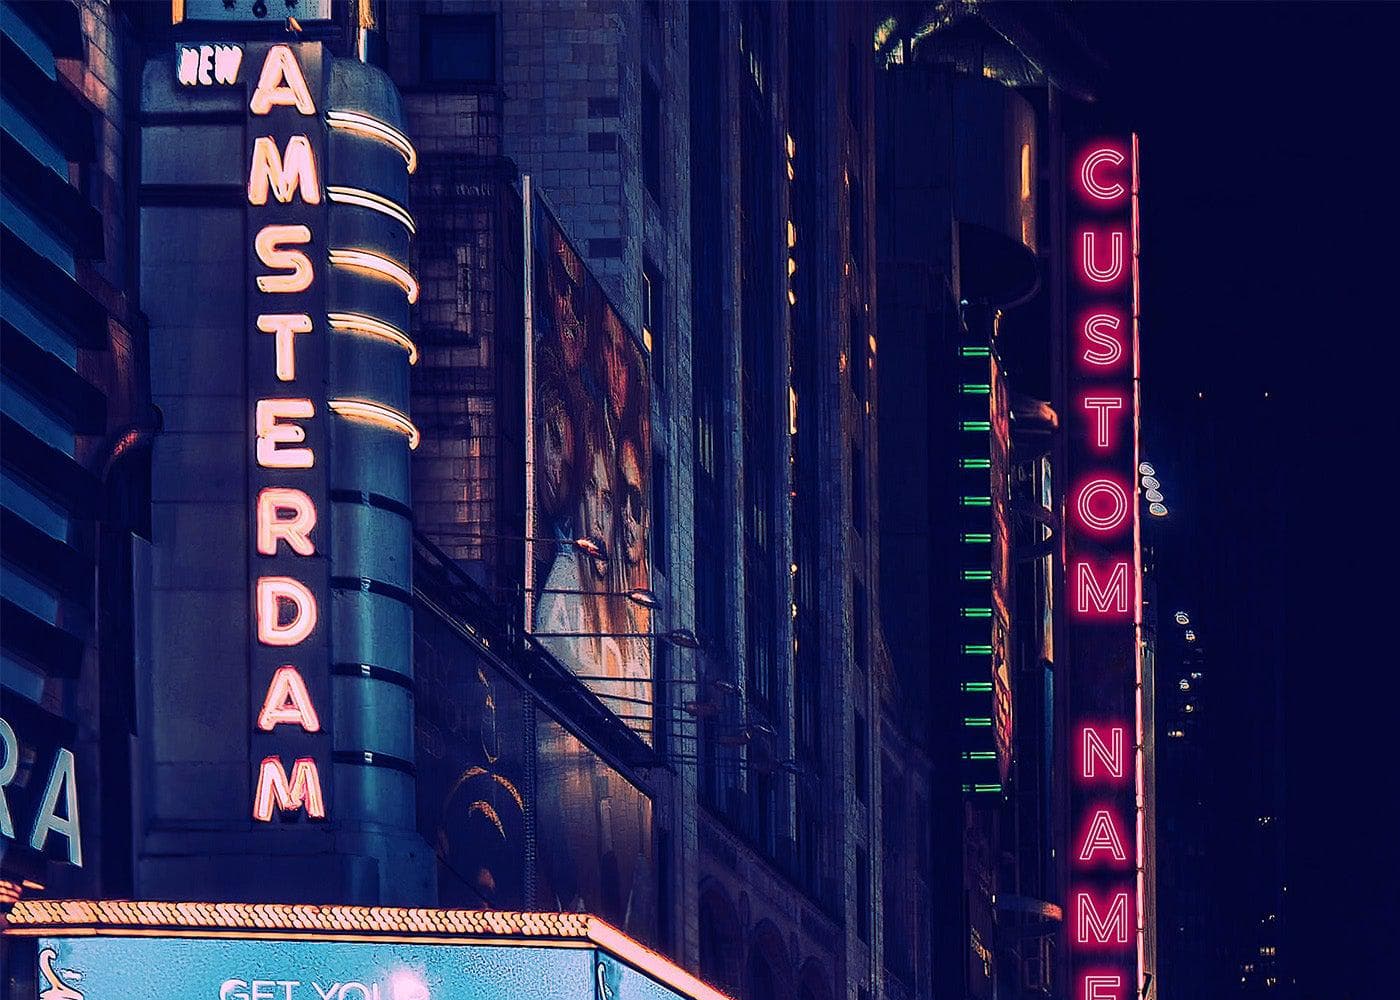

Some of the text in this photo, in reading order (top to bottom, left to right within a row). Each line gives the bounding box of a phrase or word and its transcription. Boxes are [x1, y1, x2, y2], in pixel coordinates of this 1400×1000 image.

[178, 45, 243, 85] NEW
[248, 43, 327, 822] AMSTERDAM
[1077, 148, 1128, 612] CUSTOM
